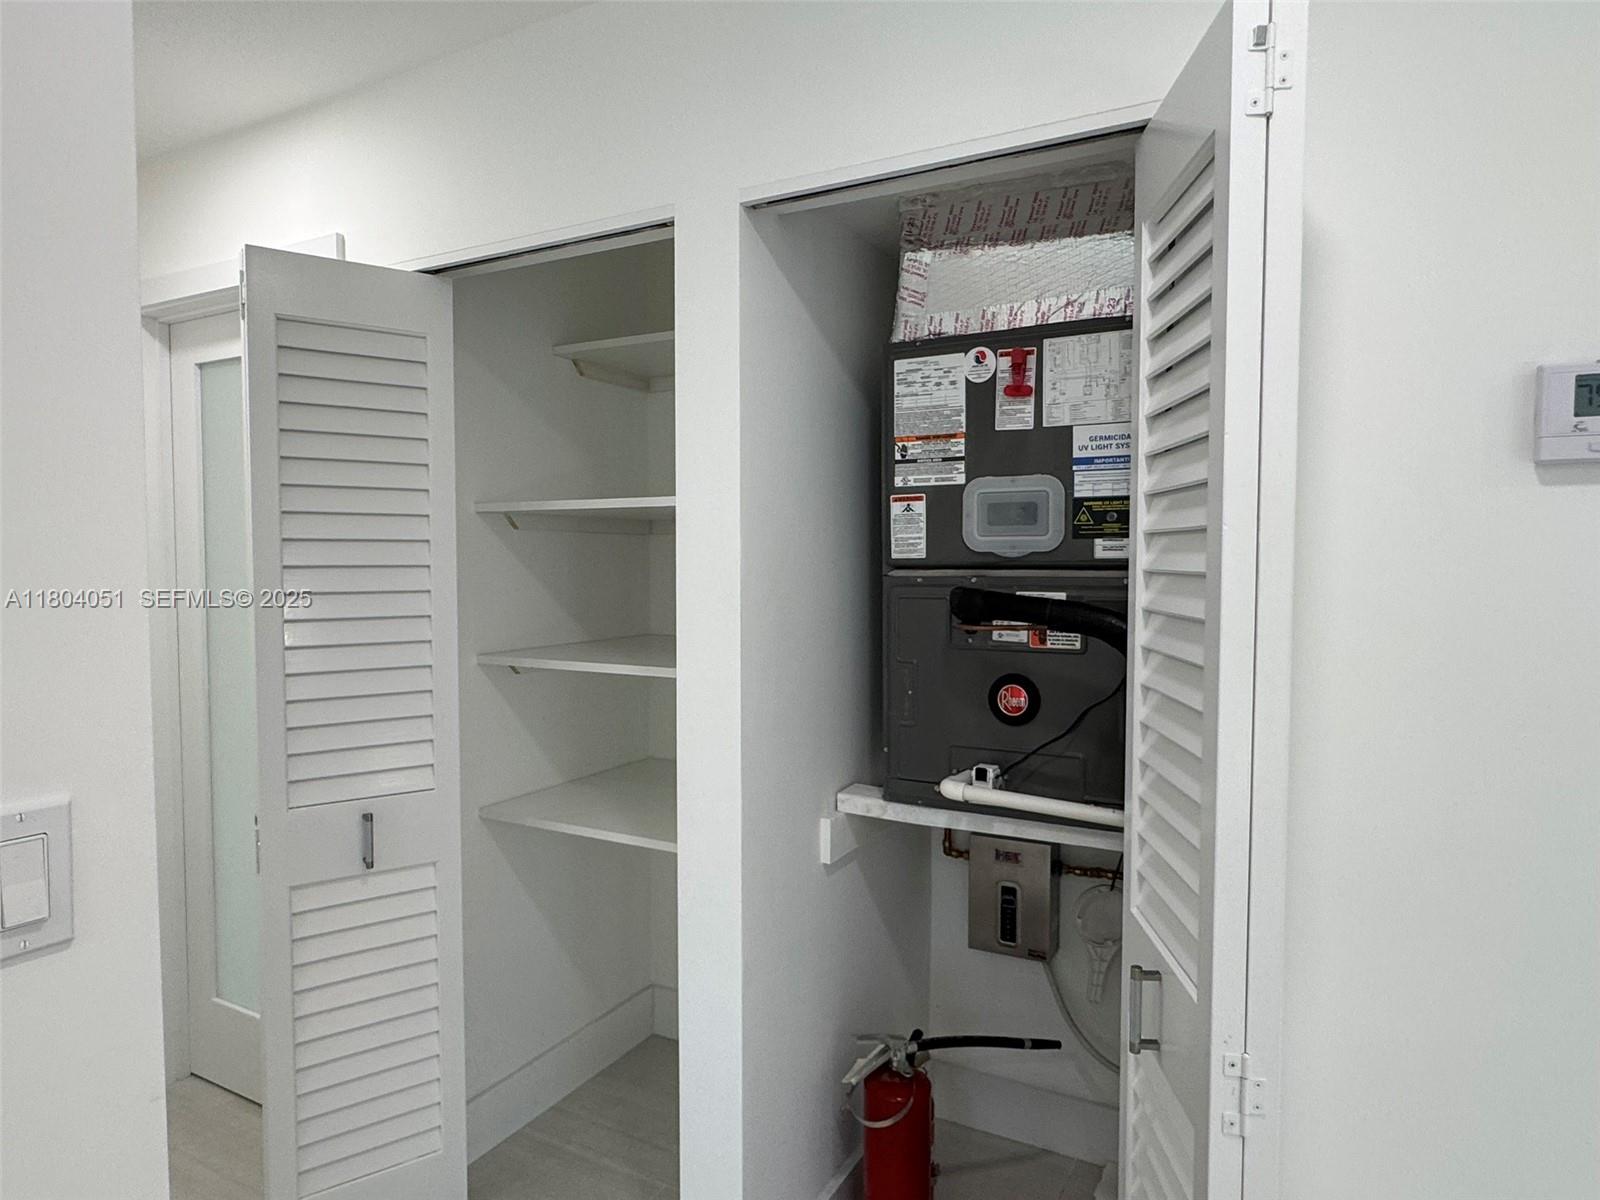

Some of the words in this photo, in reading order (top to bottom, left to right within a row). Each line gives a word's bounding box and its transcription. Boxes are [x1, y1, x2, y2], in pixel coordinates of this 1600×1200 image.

[1088, 433, 1131, 442] GERMICIDA
[1091, 443, 1113, 451] LIGHT
[1115, 442, 1131, 450] SYS
